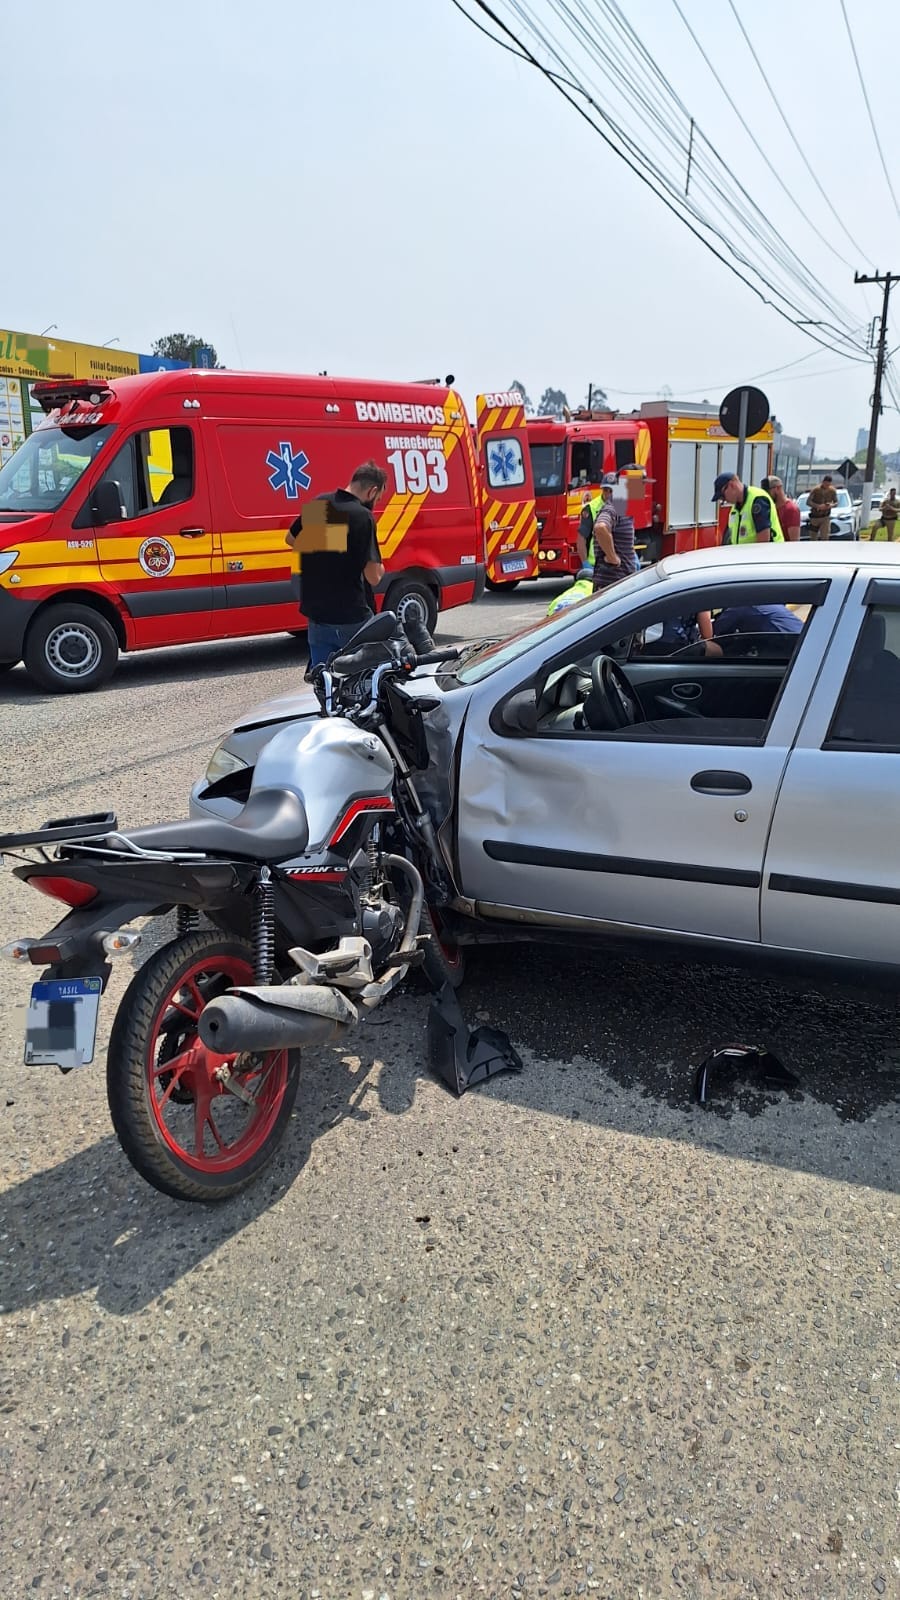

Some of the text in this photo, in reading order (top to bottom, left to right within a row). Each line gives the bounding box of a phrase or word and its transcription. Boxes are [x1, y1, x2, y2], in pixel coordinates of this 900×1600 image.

[485, 392, 524, 409] BOMB
[355, 400, 445, 425] BOMBEIROS
[384, 435, 444, 450] EMERGÊNCIA
[387, 449, 449, 494] 193
[284, 866, 333, 875] TITAN
